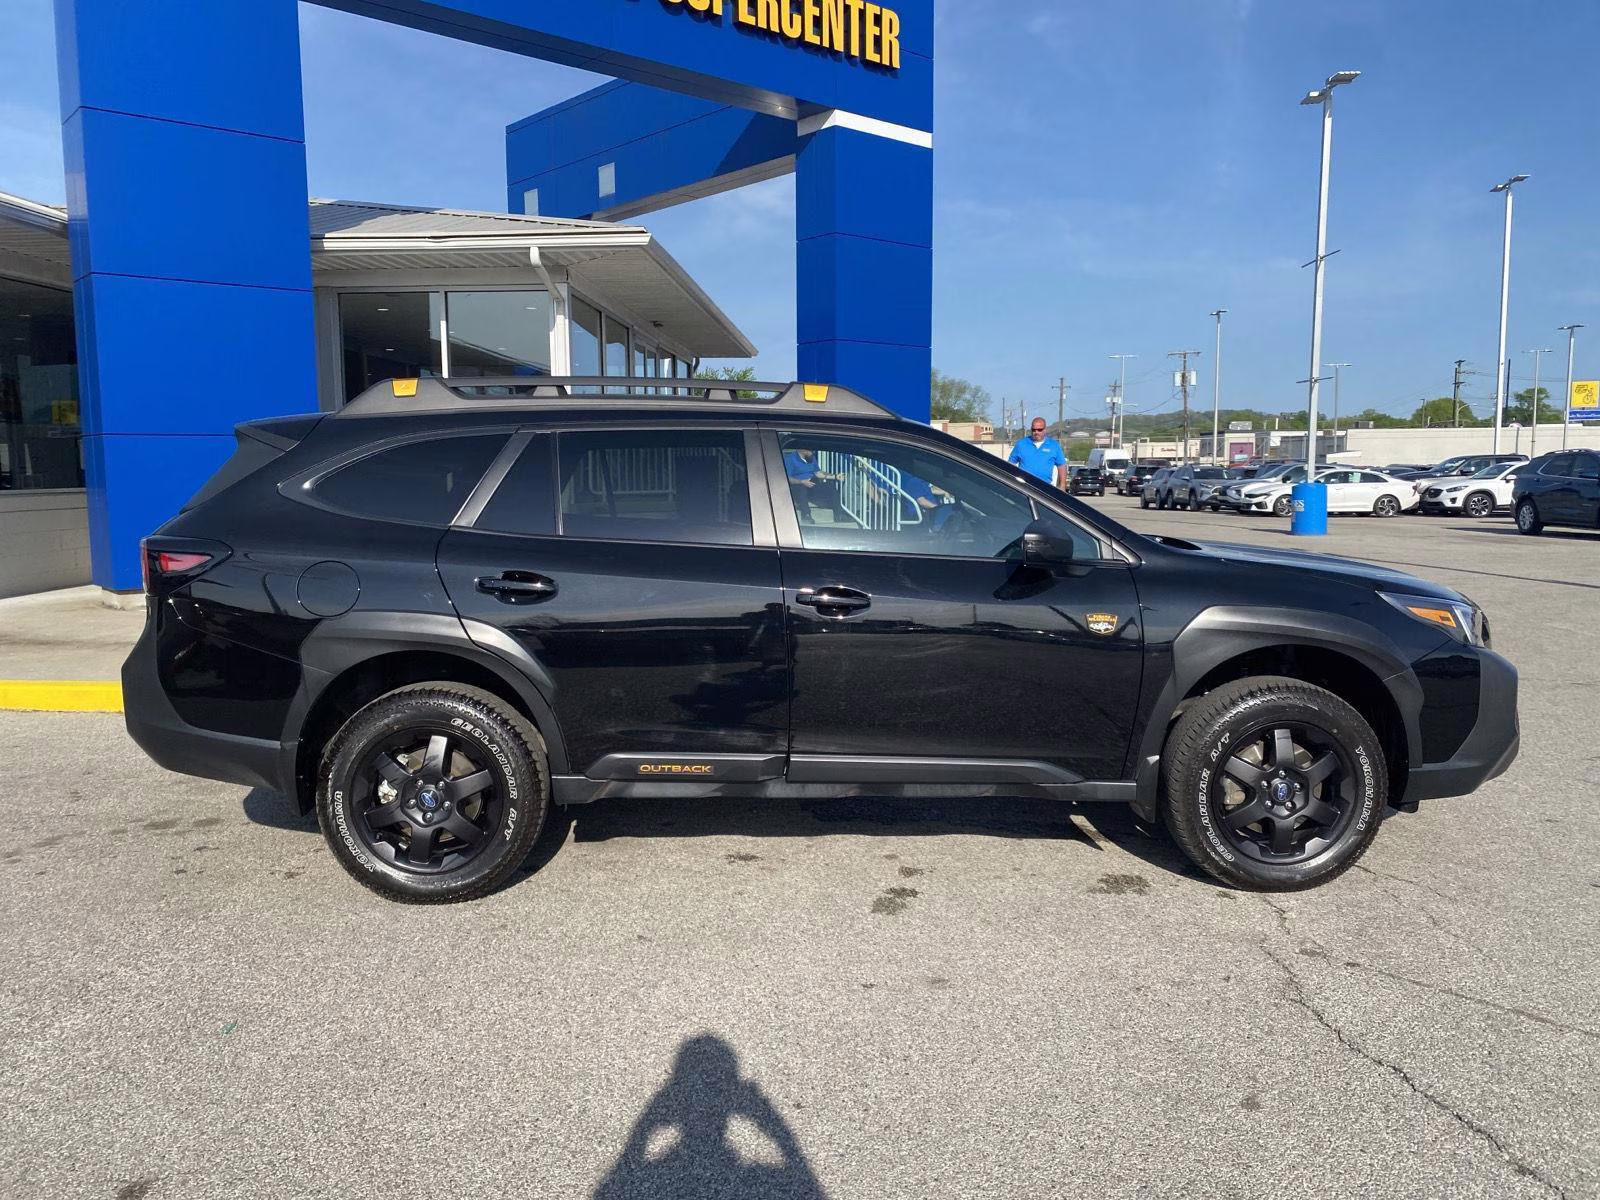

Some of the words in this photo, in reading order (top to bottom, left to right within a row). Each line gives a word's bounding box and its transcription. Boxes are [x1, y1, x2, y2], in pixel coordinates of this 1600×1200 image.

[667, 0, 900, 68] CENTER
[450, 718, 518, 800] GEOLANDAR
[504, 807, 518, 841] A/T
[639, 764, 712, 773] OUTBACK
[1355, 745, 1374, 831] YOKOHAMA
[334, 790, 376, 872] YOKOHAMA
[1198, 767, 1235, 862] GEOLANDAR
